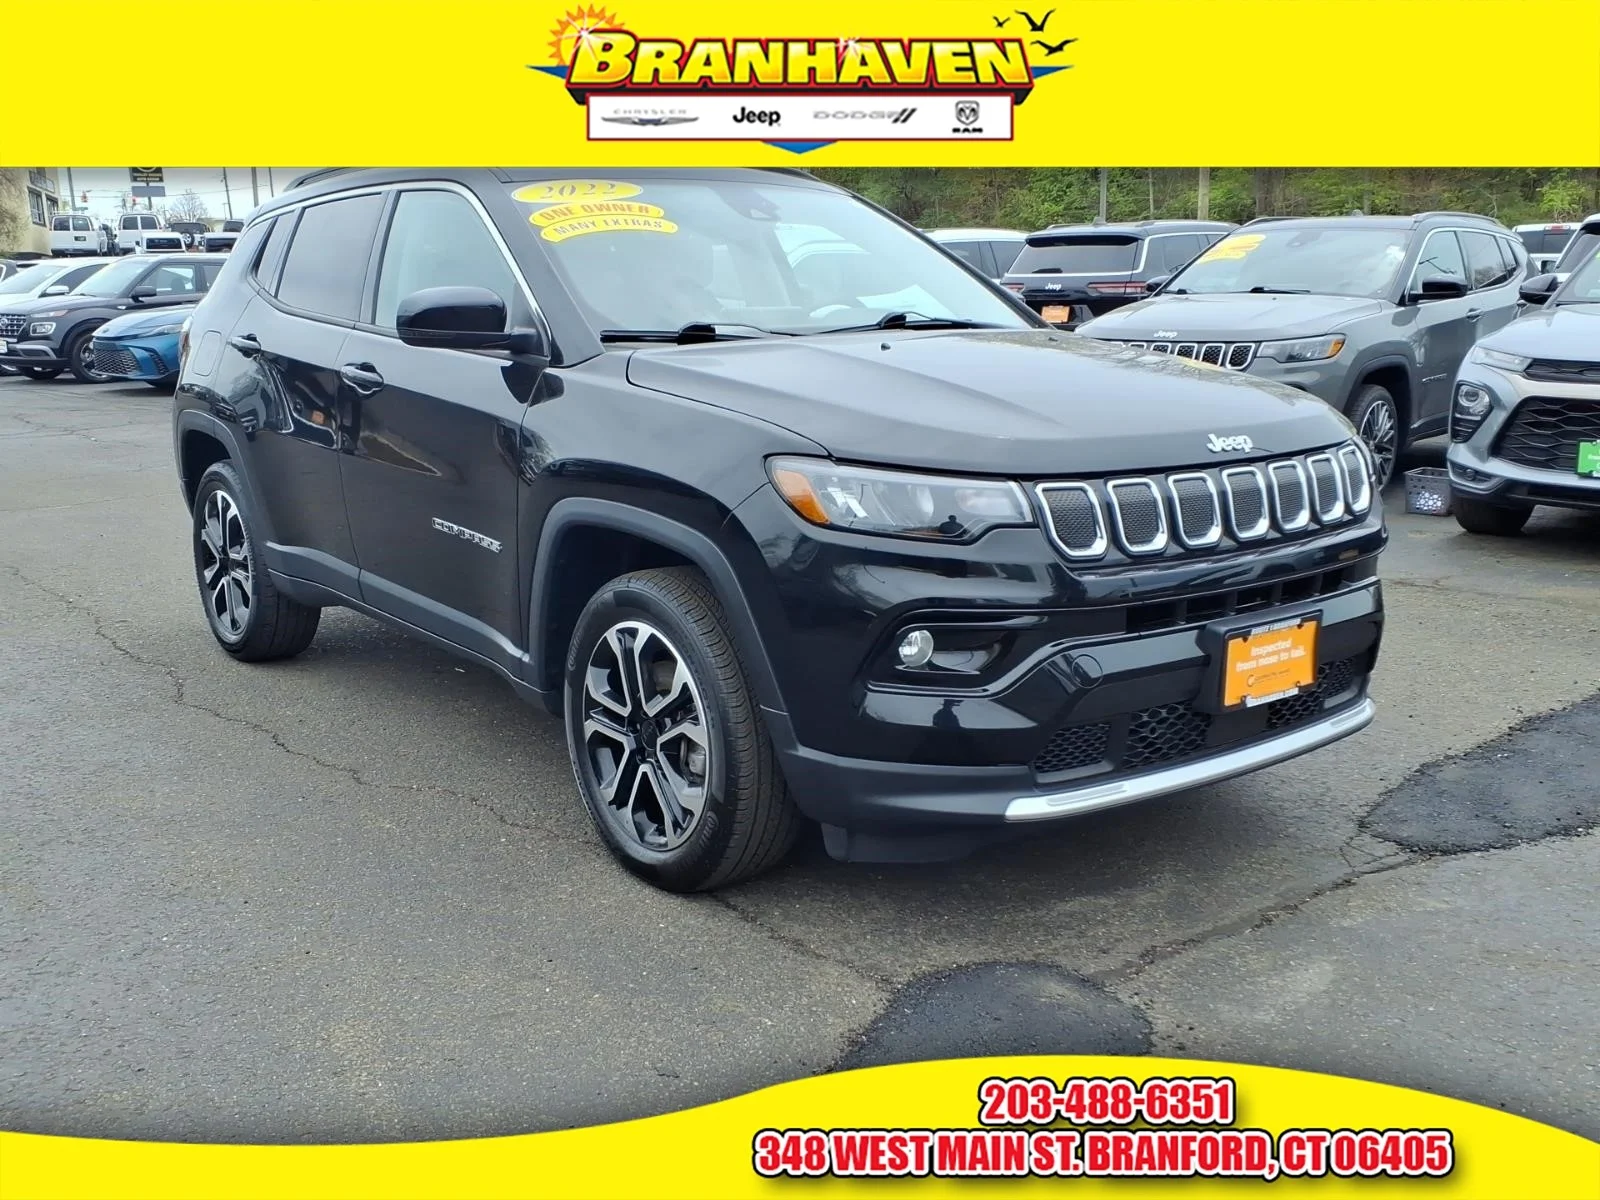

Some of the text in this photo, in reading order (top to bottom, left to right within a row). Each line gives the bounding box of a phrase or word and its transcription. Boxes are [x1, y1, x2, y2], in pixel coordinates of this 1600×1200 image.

[540, 183, 616, 199] 2022
[539, 202, 651, 222] ONE OWNER
[554, 217, 662, 236] MANY EXTRAS
[1044, 282, 1062, 291] Jeep
[1153, 330, 1178, 339] Jeep
[1206, 433, 1254, 453] Jeep
